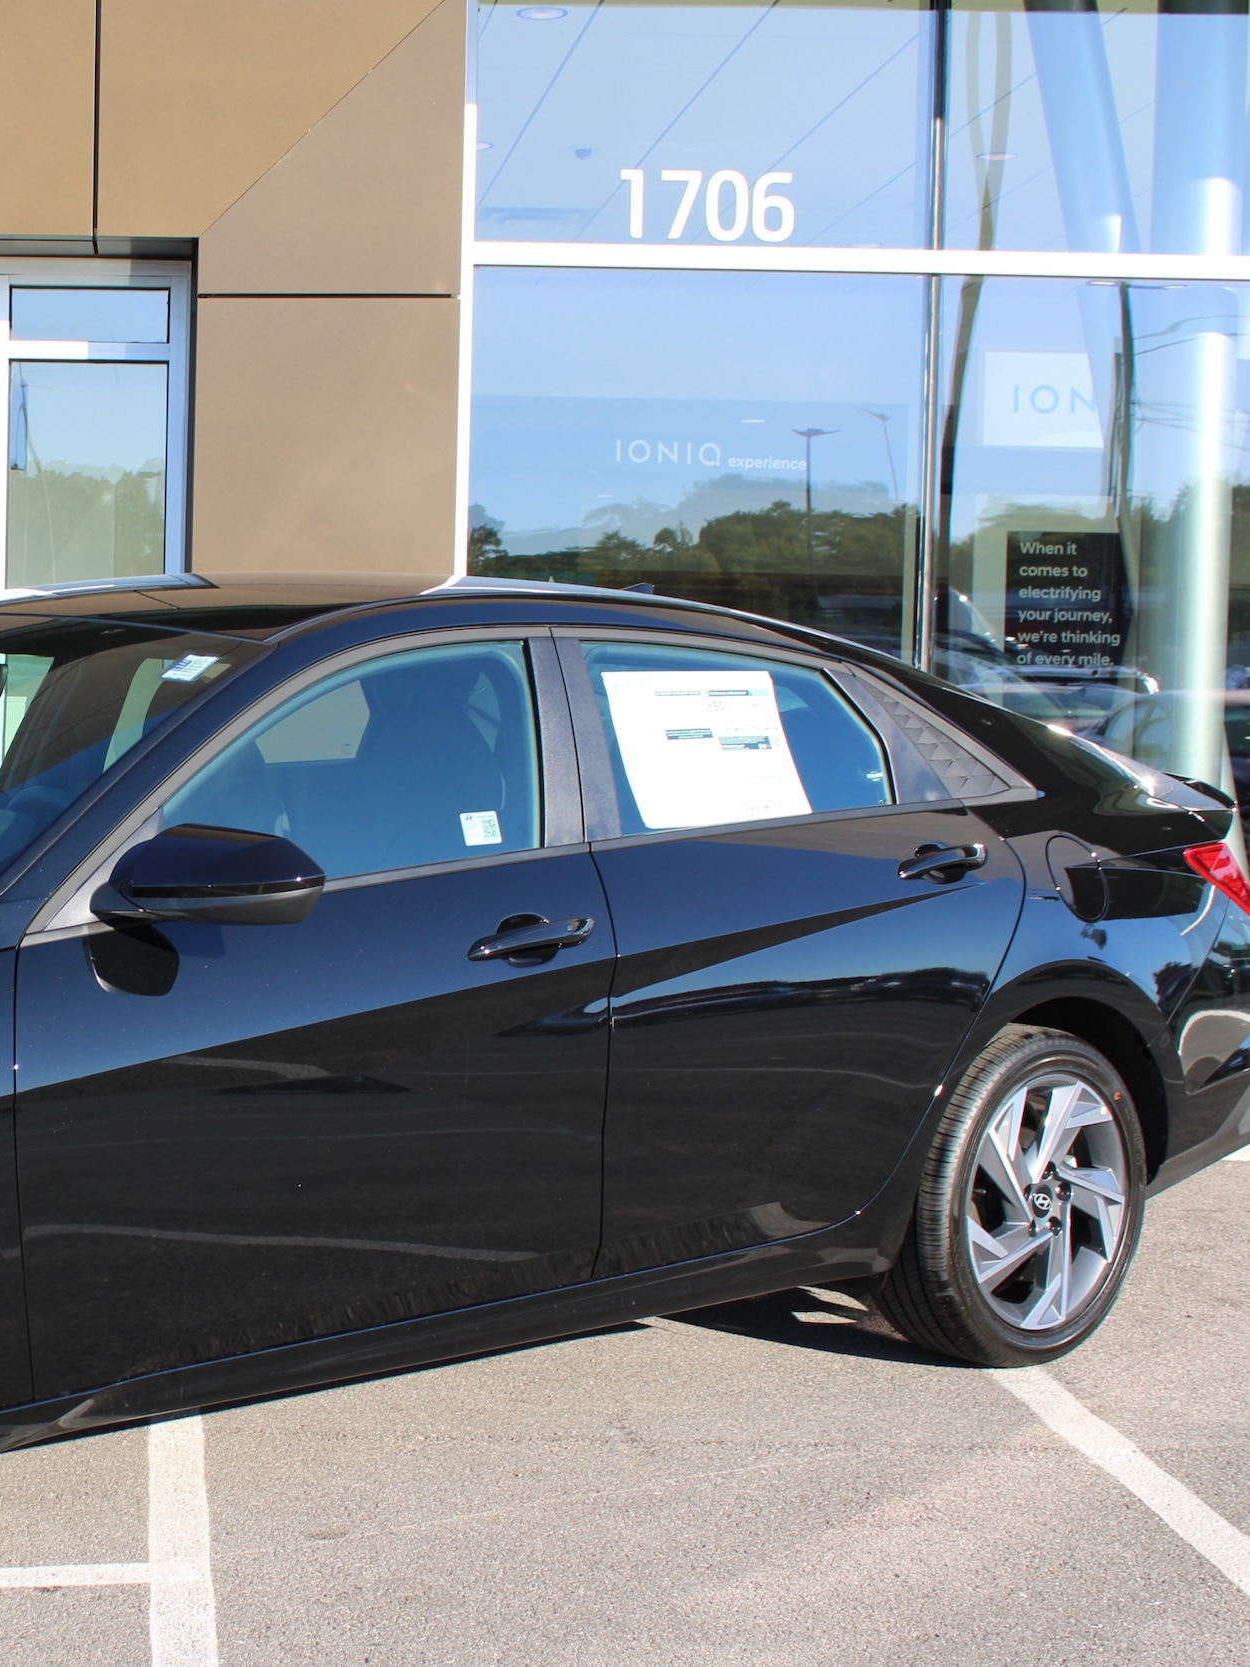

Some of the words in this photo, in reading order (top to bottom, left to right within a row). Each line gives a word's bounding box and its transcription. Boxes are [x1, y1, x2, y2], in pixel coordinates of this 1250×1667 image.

[620, 168, 795, 243] 1706
[615, 439, 722, 466] IONIQ
[728, 456, 807, 470] experience
[1020, 542, 1063, 555] When
[1067, 542, 1077, 555] it
[1019, 566, 1069, 577] comes
[1072, 565, 1088, 577] to
[1018, 586, 1101, 602] electrifying
[1018, 609, 1052, 622] your
[1054, 608, 1112, 624] journey,
[1017, 630, 1058, 643] we're
[1061, 631, 1120, 646] thinking
[1017, 652, 1032, 665] of
[1035, 654, 1076, 667] every
[1078, 653, 1114, 666] mile.
